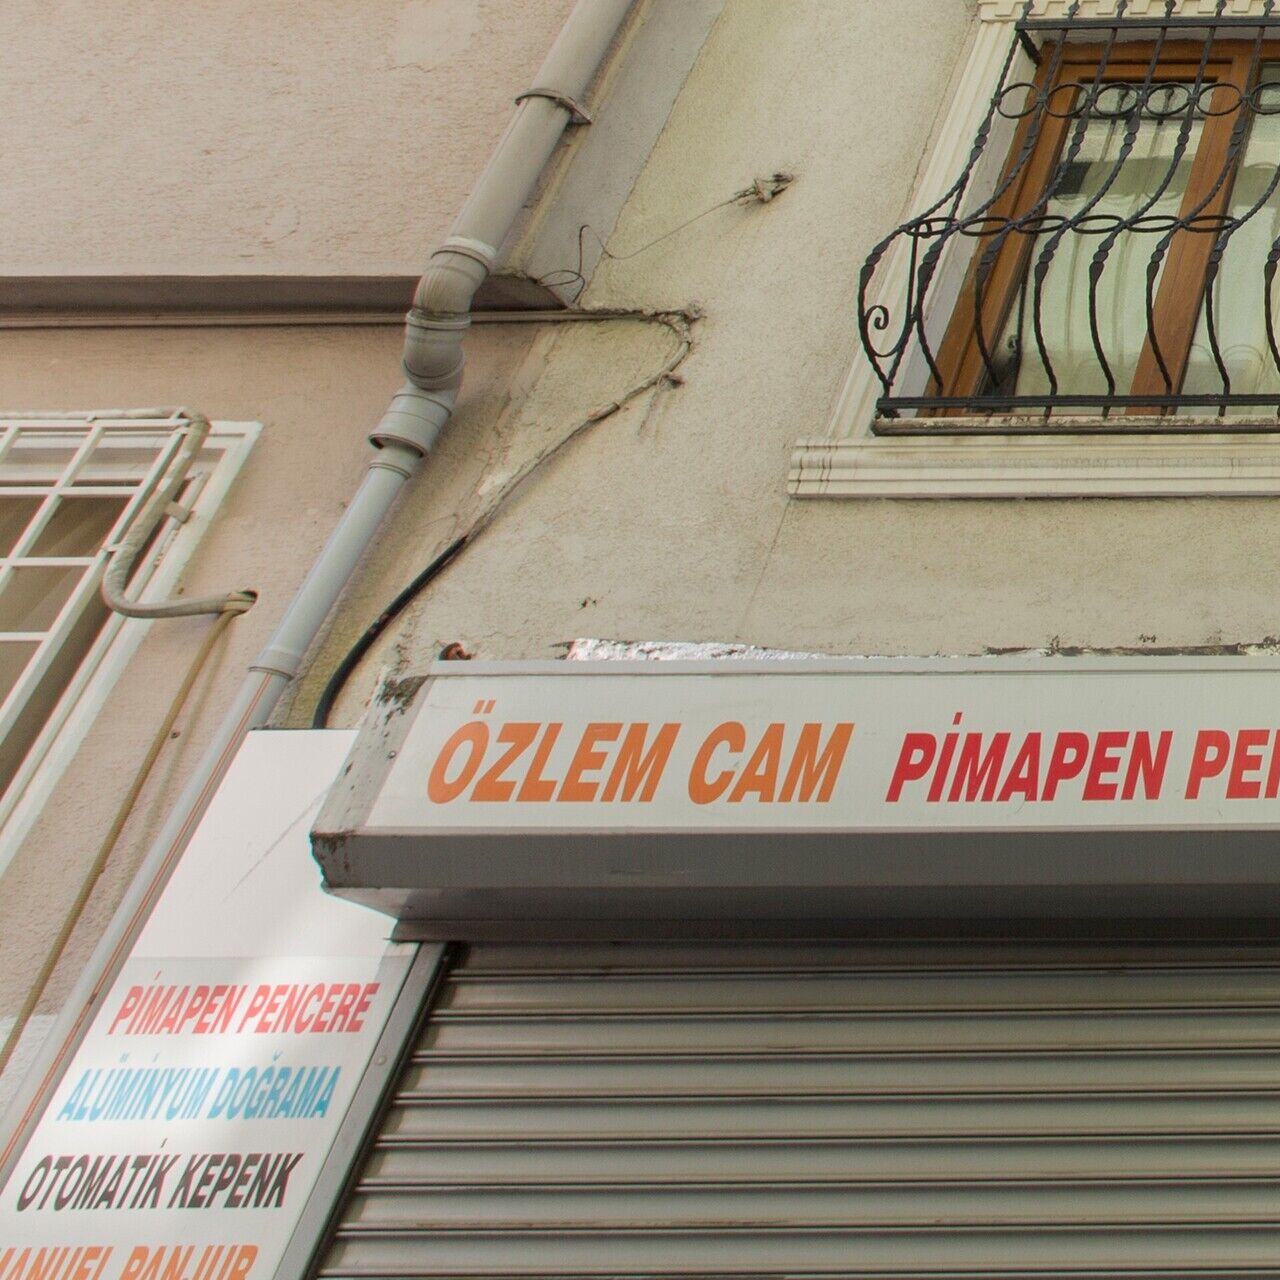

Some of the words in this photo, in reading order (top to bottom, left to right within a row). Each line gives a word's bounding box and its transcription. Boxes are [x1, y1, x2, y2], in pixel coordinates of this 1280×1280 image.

[427, 699, 682, 805] ÖZLEM
[687, 720, 855, 805] CAM
[885, 711, 1174, 802] PİMAPEN
[107, 970, 249, 1036] PİMAPEN
[235, 982, 381, 1035] PENCERE
[57, 1053, 220, 1122] ALÜMİNYUM
[208, 1051, 341, 1121] DOĞRAMA
[16, 1137, 181, 1212] OTOMATİK
[167, 1152, 305, 1209] KEPENK
